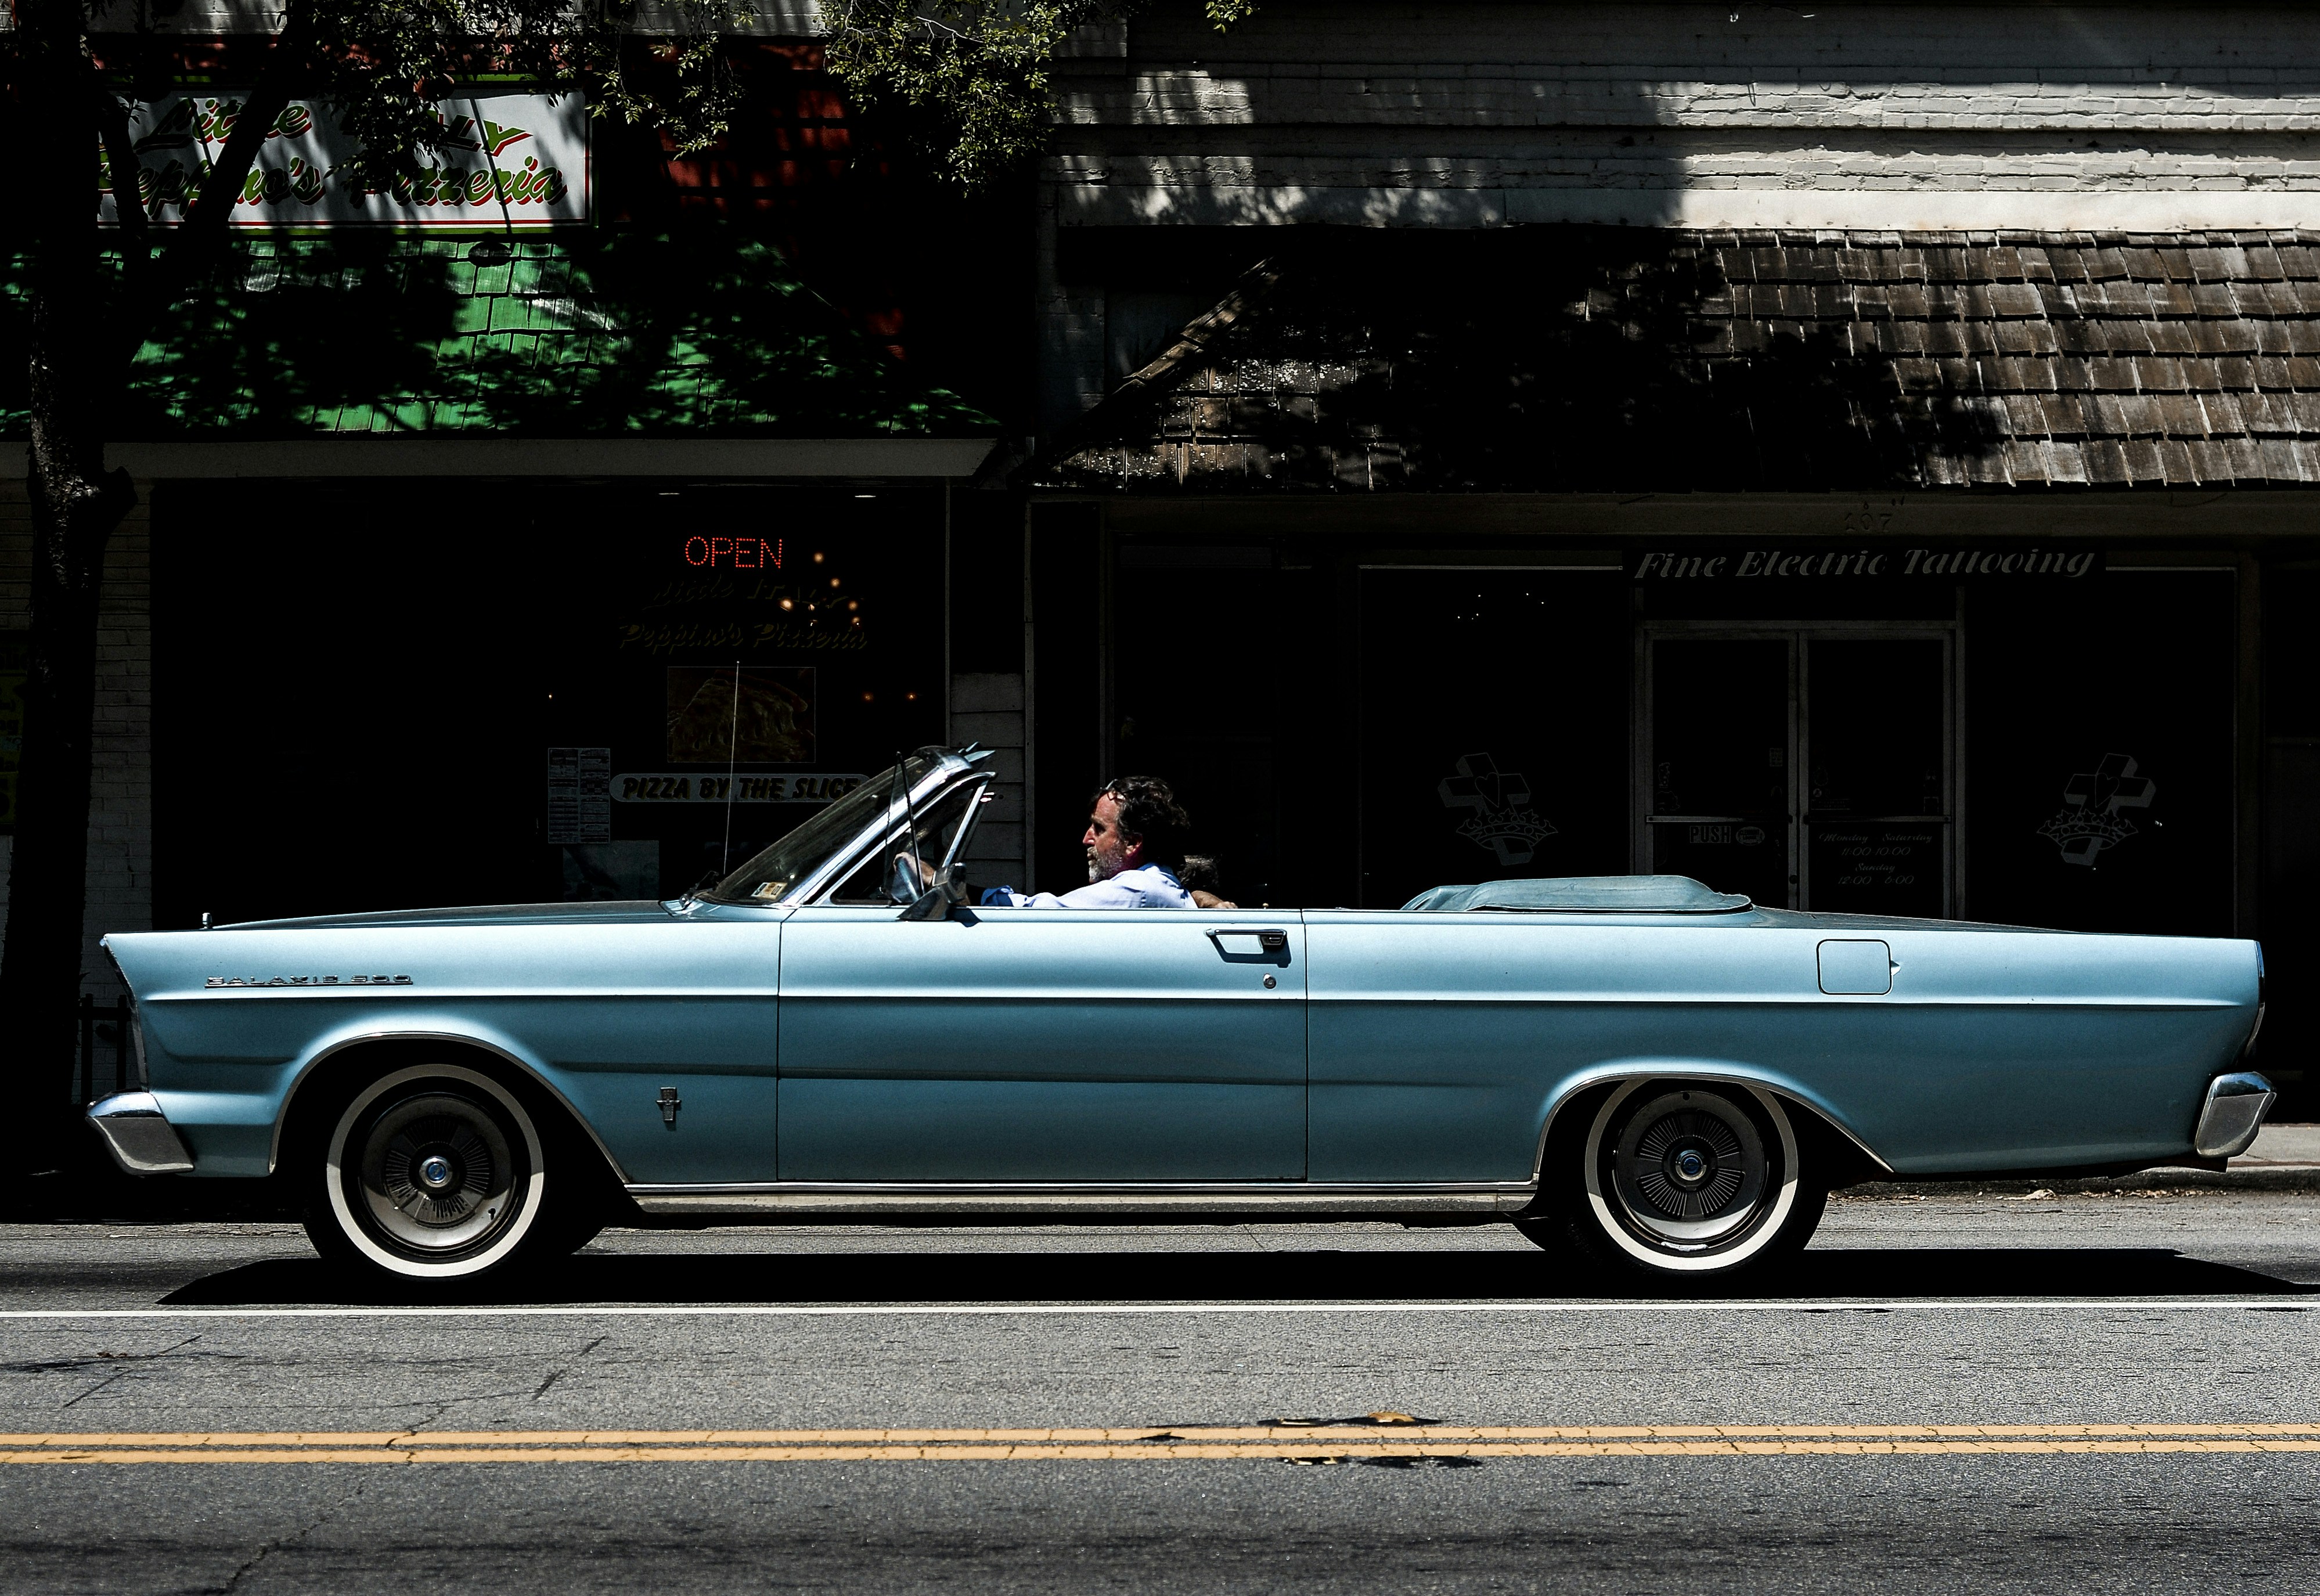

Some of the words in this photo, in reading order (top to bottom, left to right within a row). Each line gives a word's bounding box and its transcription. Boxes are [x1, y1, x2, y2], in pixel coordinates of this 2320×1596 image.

[350, 156, 568, 209] izzeria
[685, 535, 783, 569] OPEN
[1634, 552, 1728, 581] Fine
[1738, 548, 1887, 577] Electric
[1904, 548, 2095, 578] Tattooing
[623, 777, 690, 799] PIZZA
[699, 777, 731, 799] BY
[739, 777, 784, 799] THE
[792, 777, 859, 799] SLICE
[1691, 826, 1729, 842] PUSH
[1818, 833, 1868, 844] Monday
[1882, 833, 1933, 844] Saturday
[1855, 862, 1895, 874] Sunday
[1838, 875, 1872, 885] 12:00
[1885, 875, 1914, 885] 6:00
